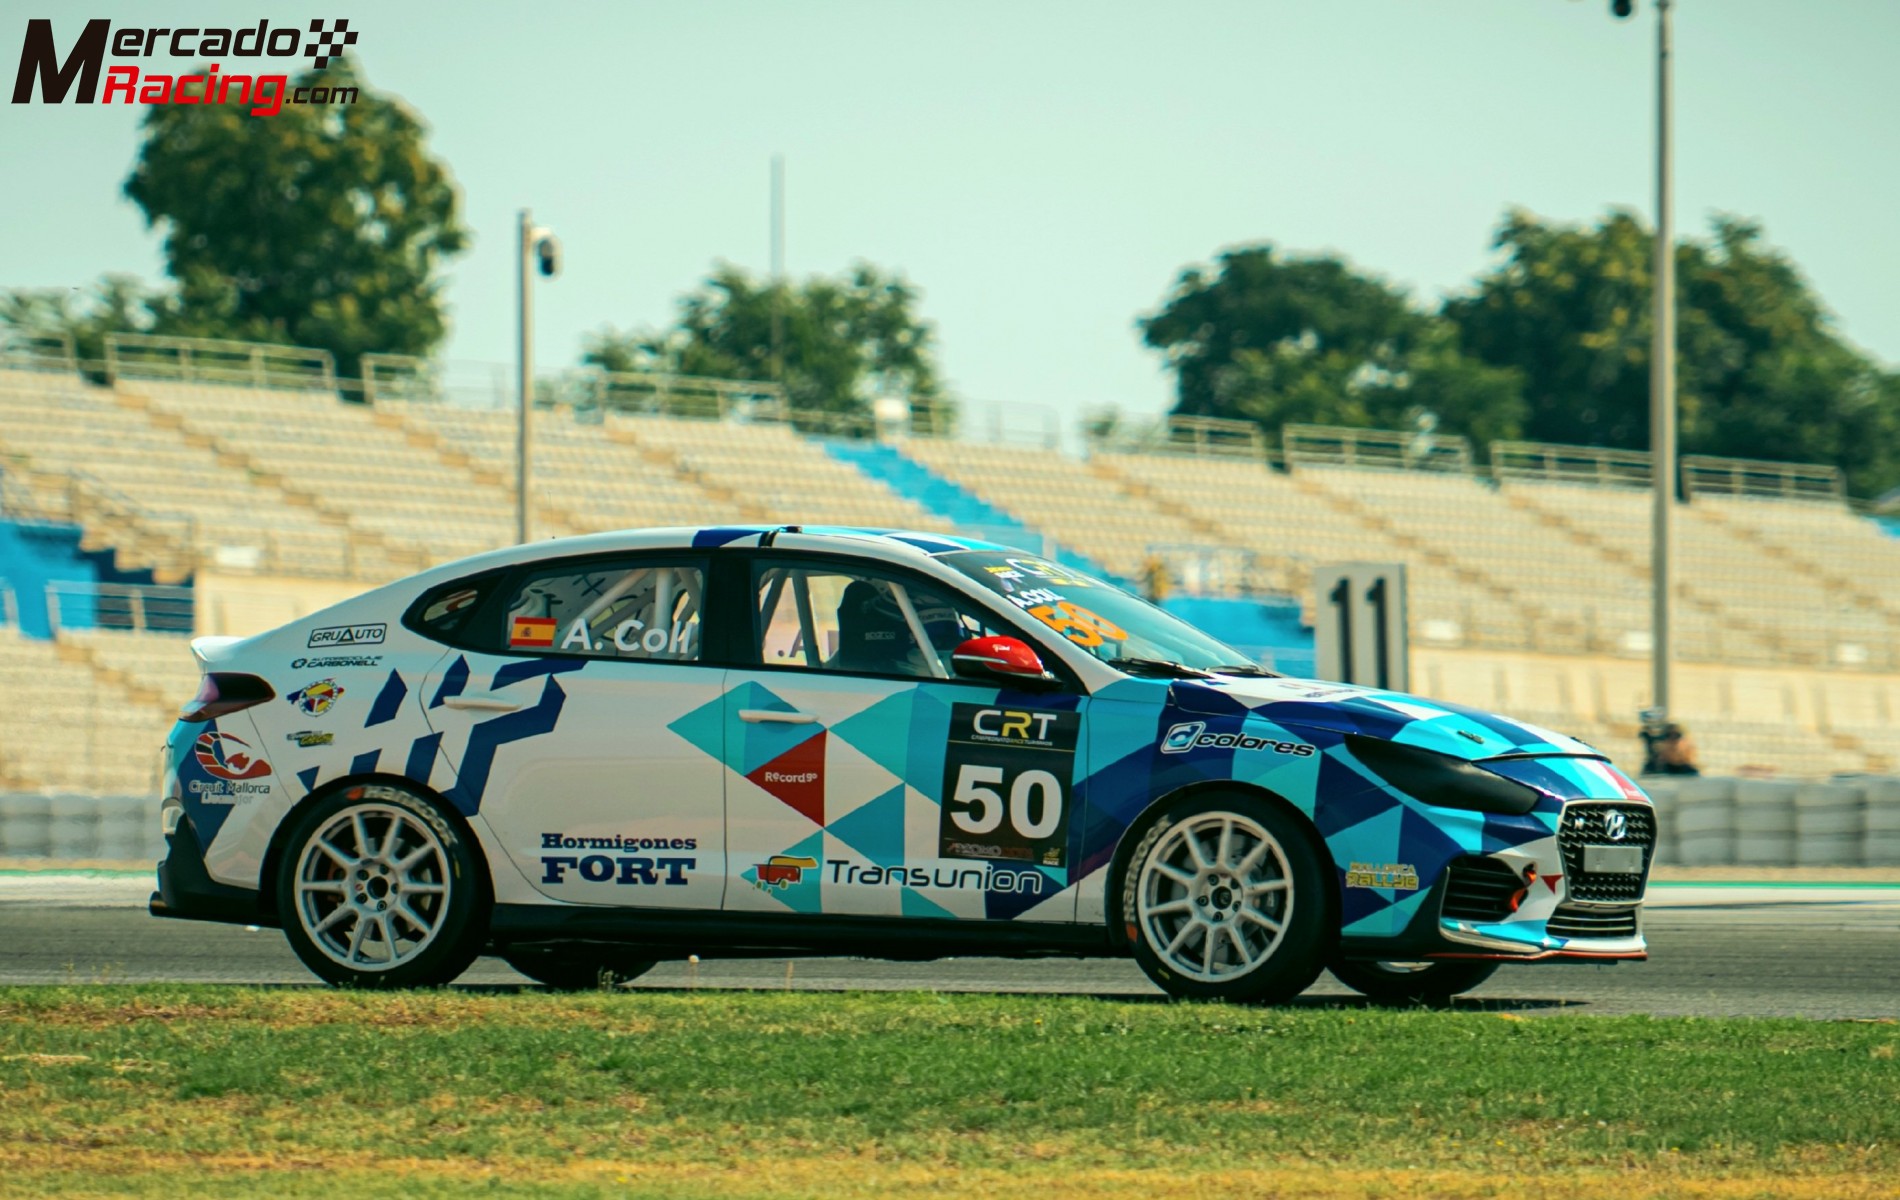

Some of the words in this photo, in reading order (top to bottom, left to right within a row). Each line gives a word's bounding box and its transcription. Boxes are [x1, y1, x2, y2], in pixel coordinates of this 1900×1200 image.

[311, 626, 384, 643] GRUAUTO
[561, 617, 604, 651] A.
[613, 618, 694, 654] Coll
[1027, 601, 1128, 647] 50
[1329, 577, 1389, 690] 11
[306, 660, 378, 668] CARBONELL
[973, 709, 1058, 740] CRT
[227, 782, 271, 794] Mallorca
[950, 764, 1063, 839] 50
[541, 832, 697, 852] Hormigones
[541, 855, 697, 886] FORT
[827, 860, 1042, 893] Transunion
